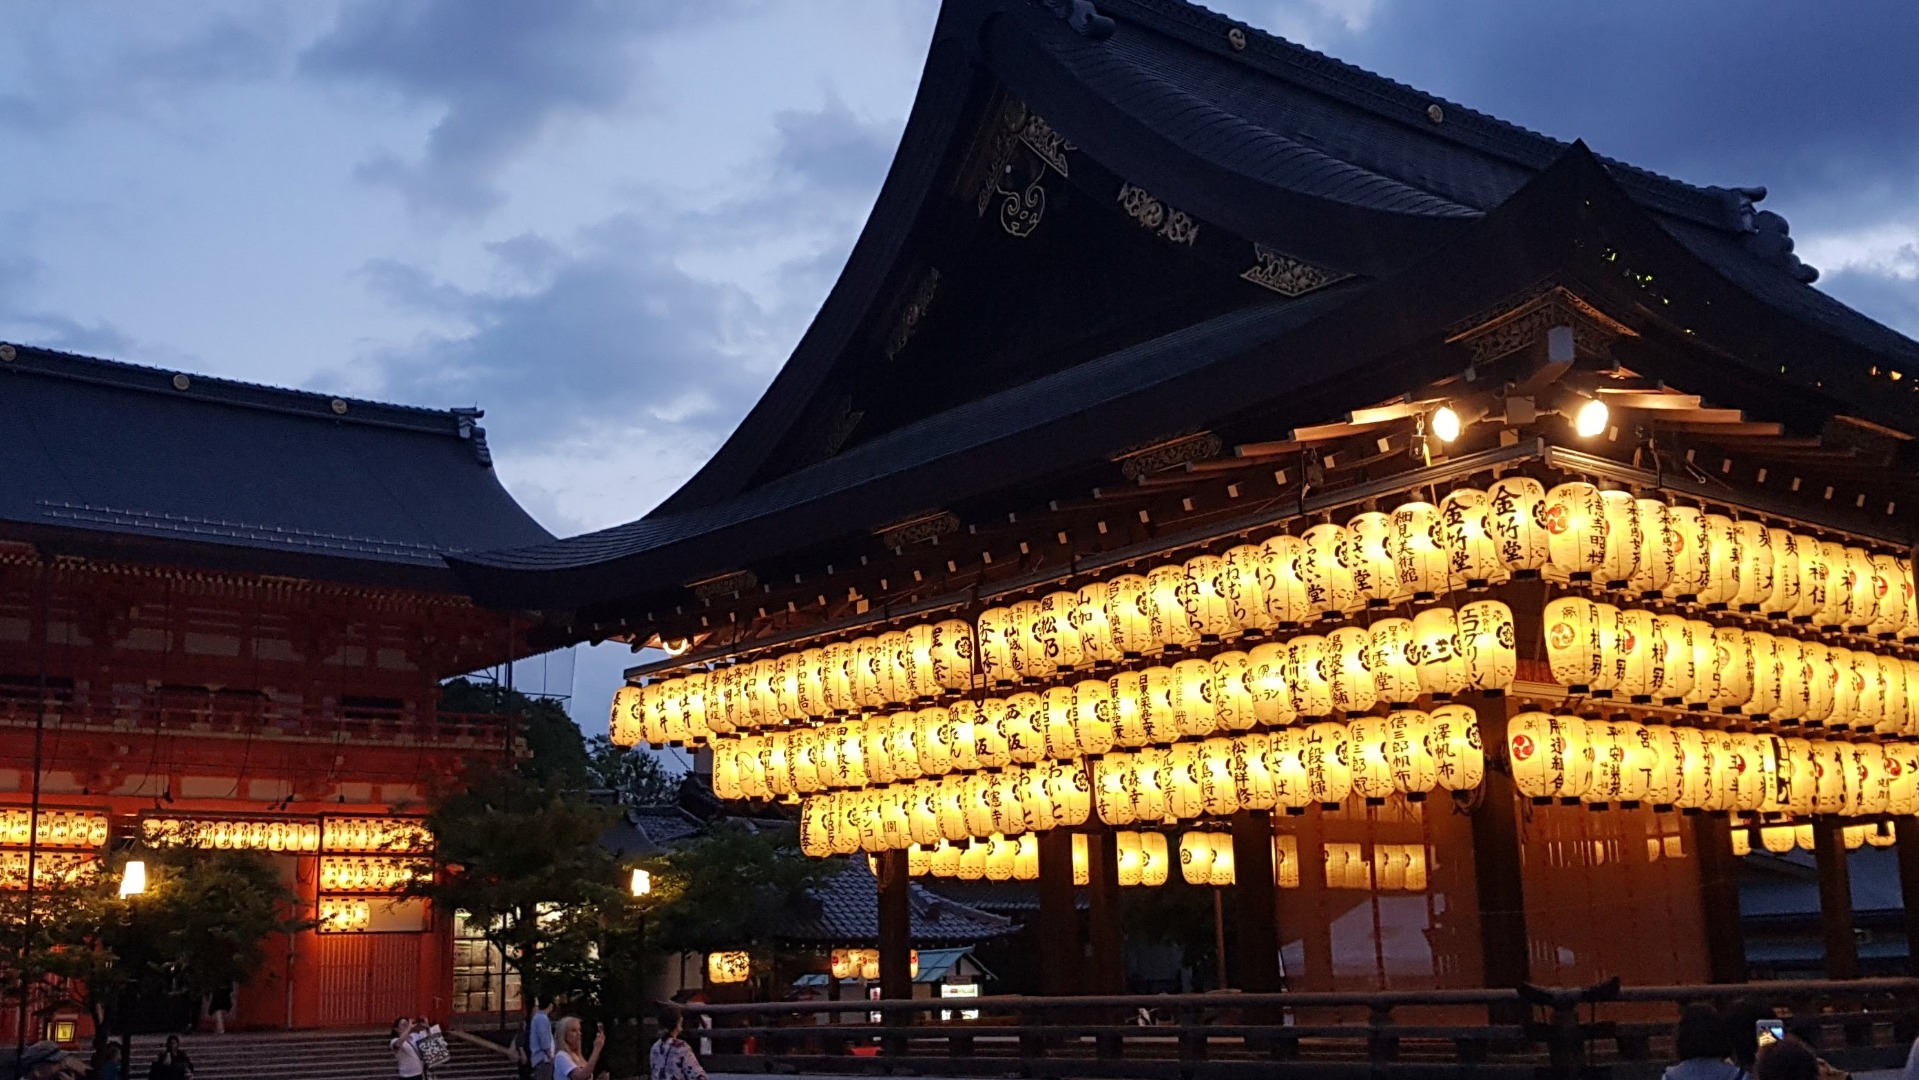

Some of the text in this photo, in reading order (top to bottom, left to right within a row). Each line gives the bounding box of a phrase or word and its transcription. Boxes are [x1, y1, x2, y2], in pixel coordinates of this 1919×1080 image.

[1349, 518, 1374, 592] てっさい堂
[1393, 510, 1419, 584] 細見美術館
[1442, 497, 1473, 573] 金竹堂
[1490, 484, 1525, 563] 金竹堂
[1183, 562, 1204, 630] よねむら
[1225, 552, 1246, 621] よねむら
[1260, 542, 1285, 614] 吉うた
[1302, 531, 1327, 604] てっさい堂
[1077, 590, 1098, 652] 山加代
[1461, 607, 1484, 685] エコグリーン
[1588, 603, 1602, 677] 月桂冠
[1614, 610, 1627, 682] 月桂冠
[1649, 617, 1665, 689] 月桂冠
[1288, 644, 1309, 713] 荒川氷室
[1328, 633, 1351, 706] 湯波半老舗
[1370, 630, 1394, 692] 彩雲堂
[1043, 691, 1056, 755] NOSTER
[1071, 685, 1084, 748] NOSTER
[1109, 678, 1126, 741] 日東薬品工業
[1138, 673, 1158, 738] 日東薬品工業
[1390, 715, 1412, 790] 信三郎帆布
[1432, 712, 1456, 781] 一澤帆布
[860, 796, 874, 838] パチンコ
[1049, 761, 1064, 819] おいと
